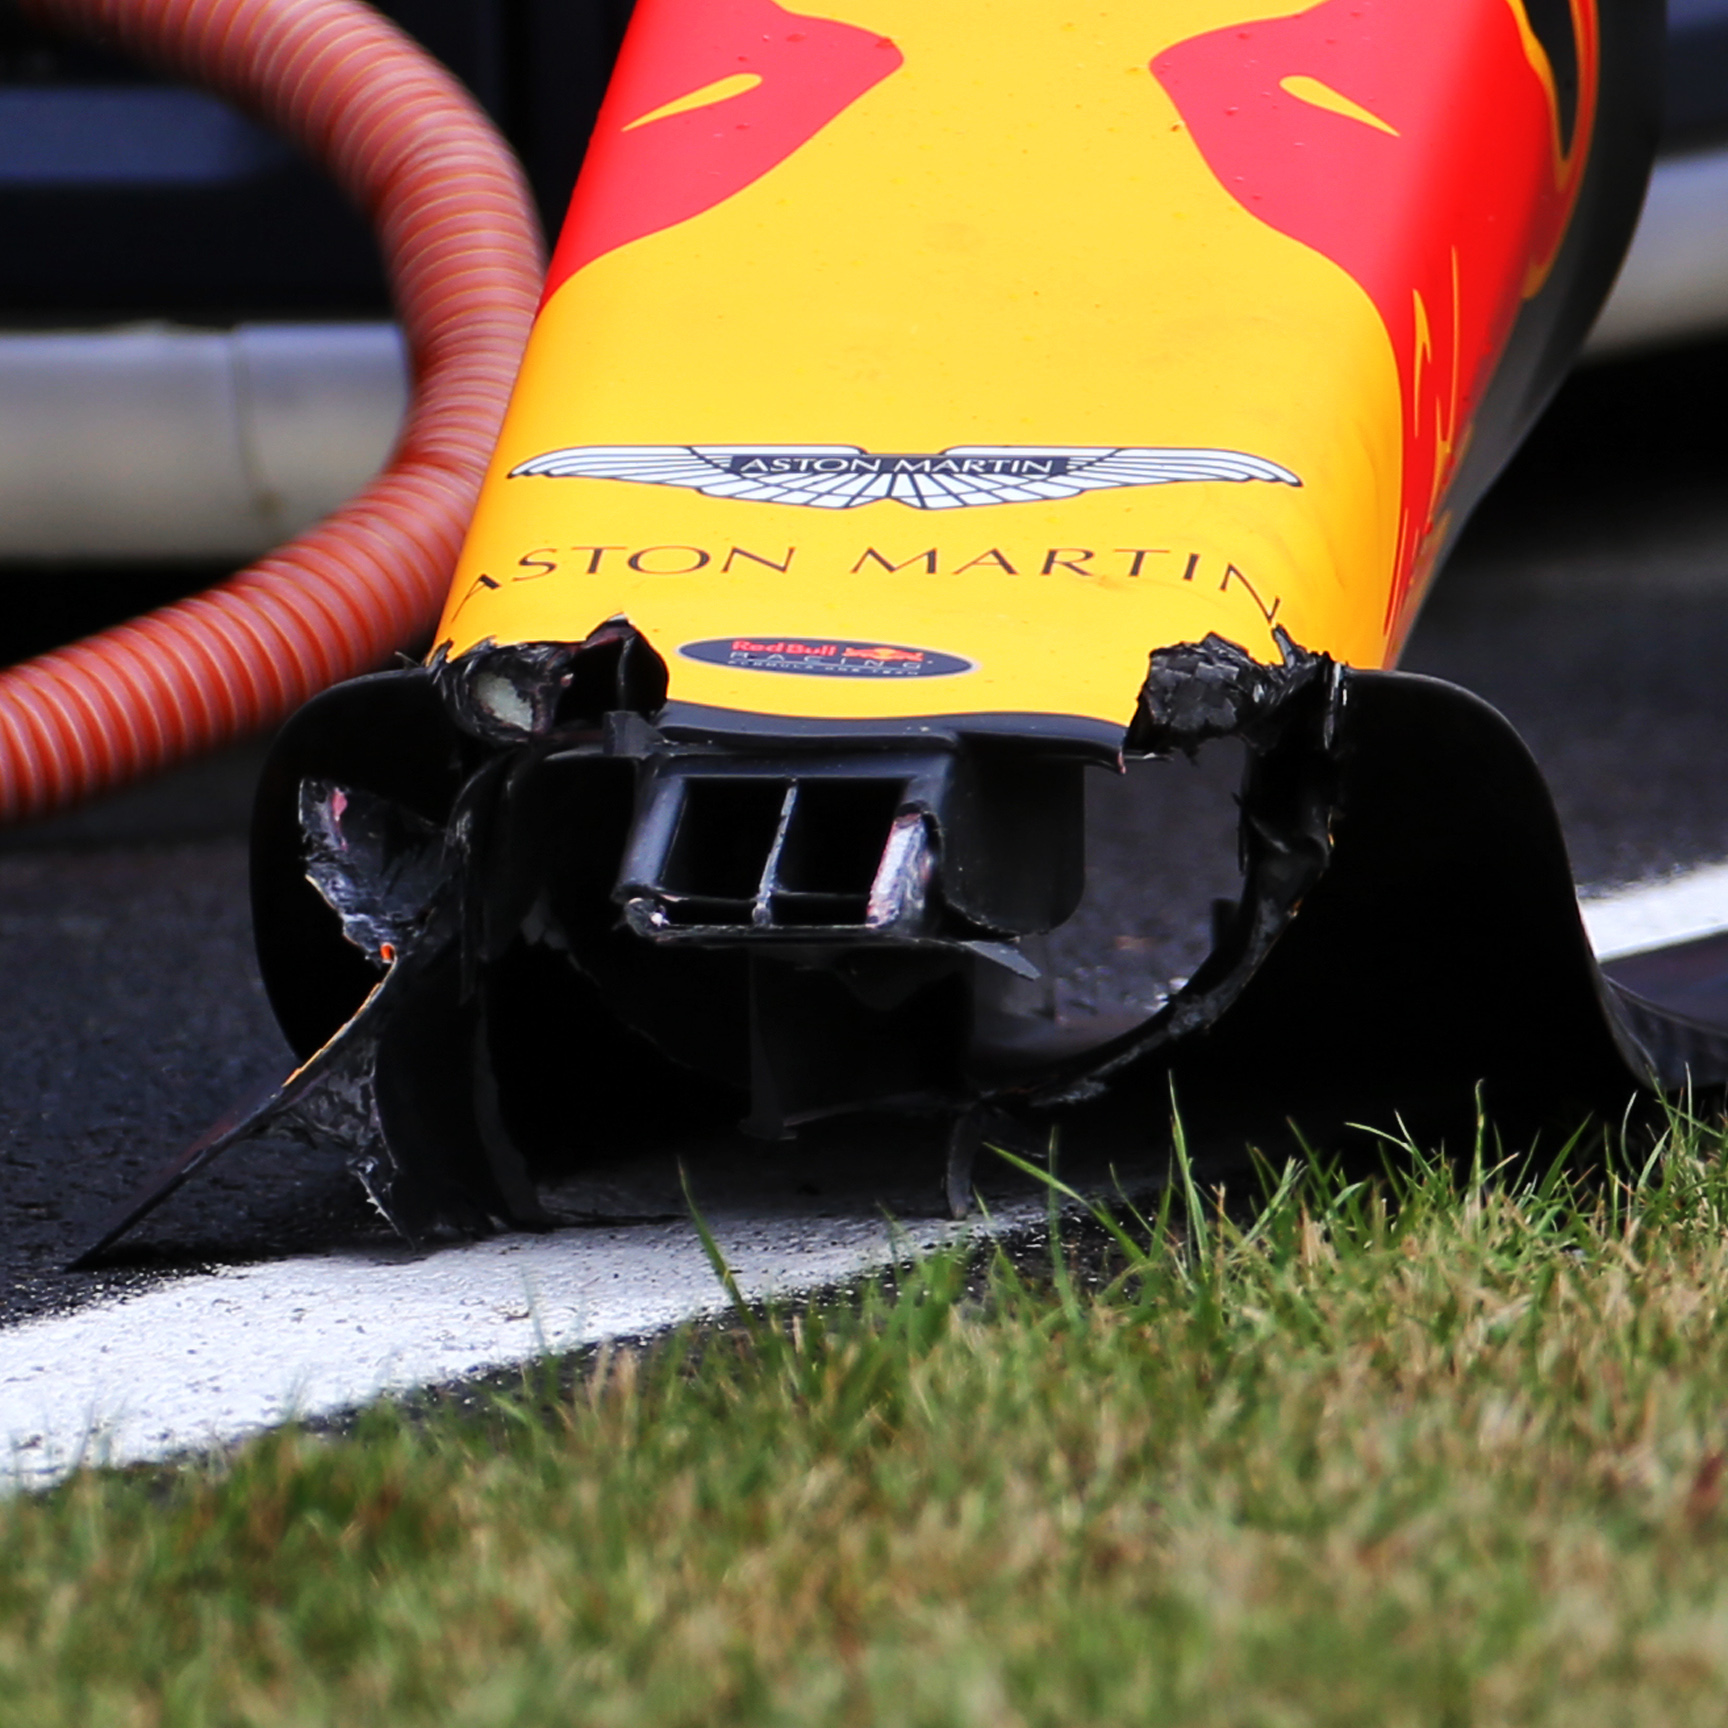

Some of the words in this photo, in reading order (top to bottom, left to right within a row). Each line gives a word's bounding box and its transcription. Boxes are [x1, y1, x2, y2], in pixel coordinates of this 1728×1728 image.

[739, 457, 882, 473] ASTON
[892, 457, 1053, 474] MARTIN
[450, 544, 796, 625] ASTON
[850, 547, 1281, 625] MARTIN
[730, 638, 785, 653] Red
[785, 641, 838, 657] Bull
[729, 651, 922, 670] RACING
